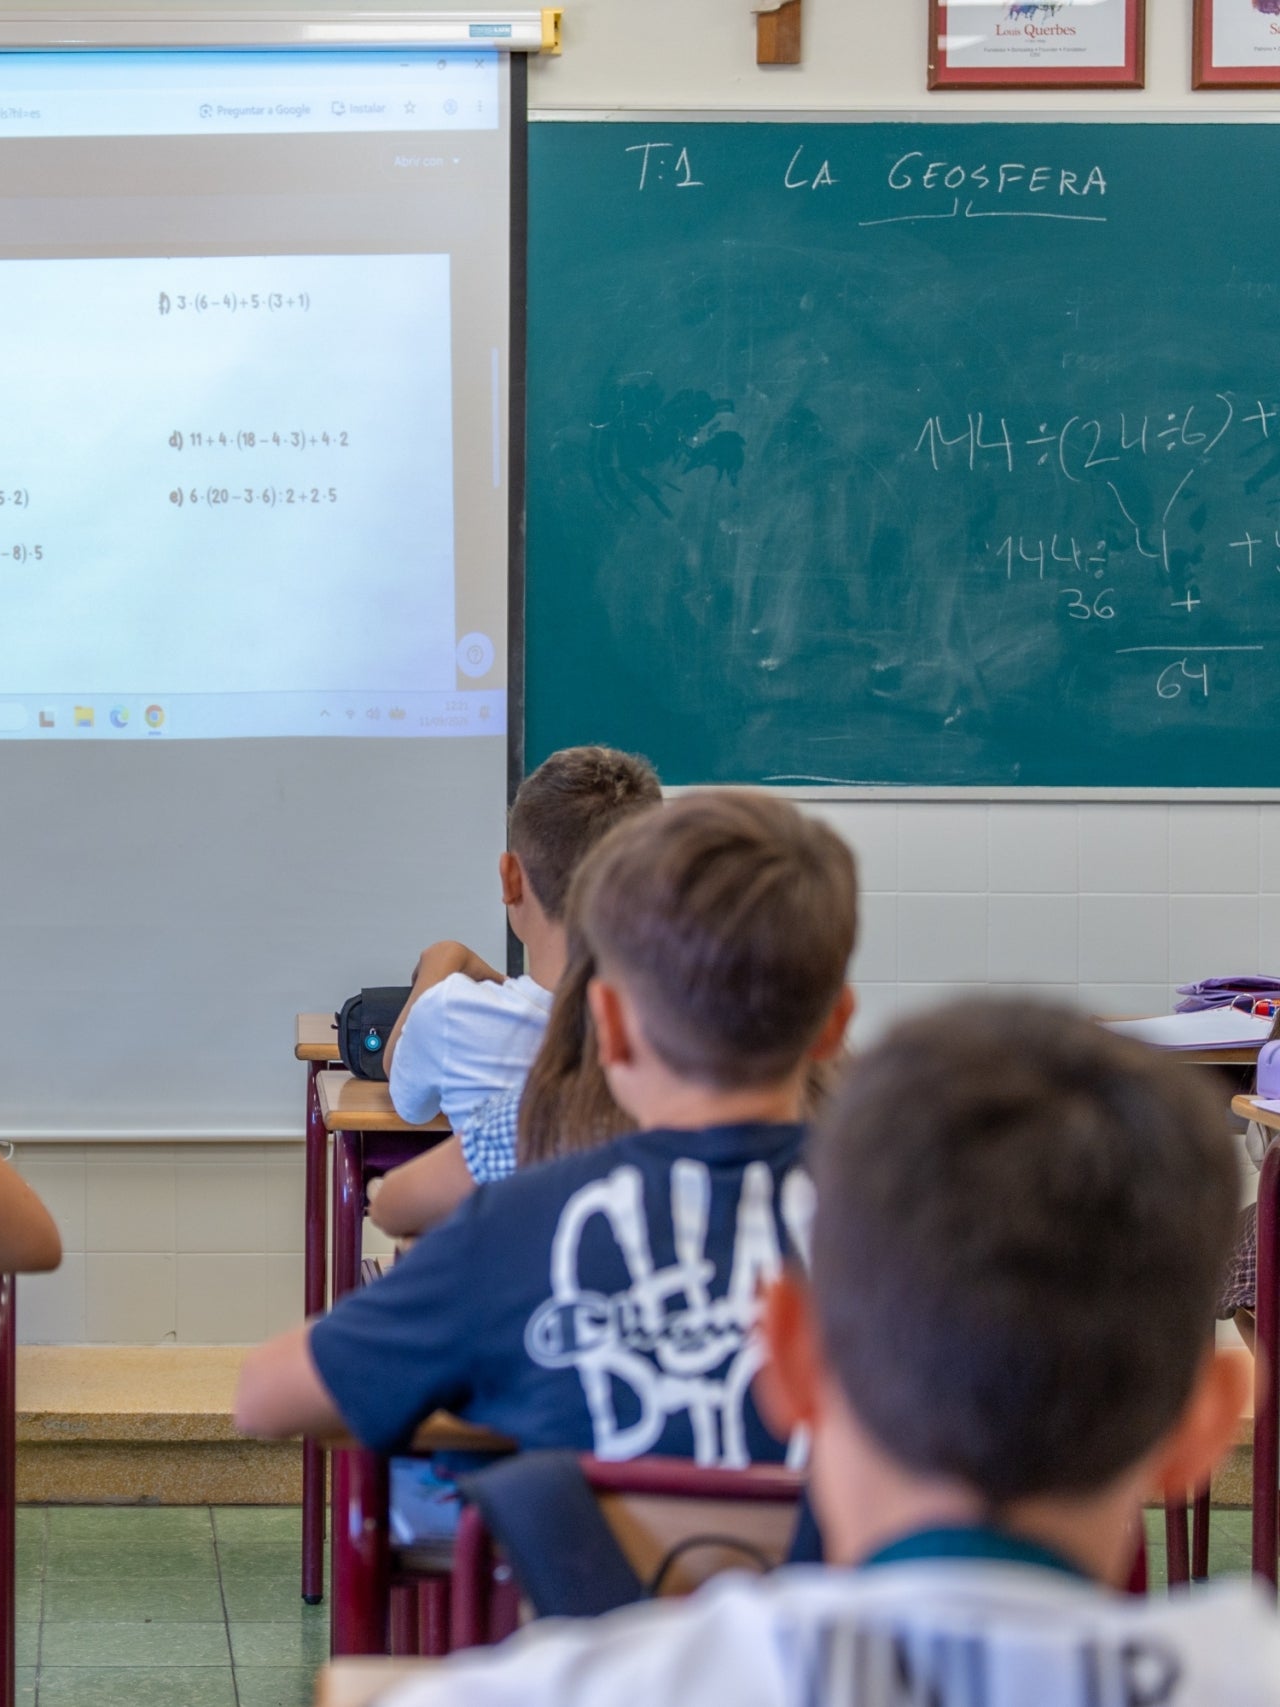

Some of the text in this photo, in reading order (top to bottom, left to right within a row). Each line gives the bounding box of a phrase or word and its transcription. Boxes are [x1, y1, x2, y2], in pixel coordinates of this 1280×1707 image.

[995, 23, 1077, 38] Louis Querbes
[217, 105, 265, 118] Preguntar
[275, 103, 311, 117] Google
[349, 103, 386, 114] Instalar
[783, 144, 842, 192] LA
[887, 151, 1108, 195] GEOSFERA
[1060, 588, 1116, 620] 36
[1156, 657, 1209, 699] 64
